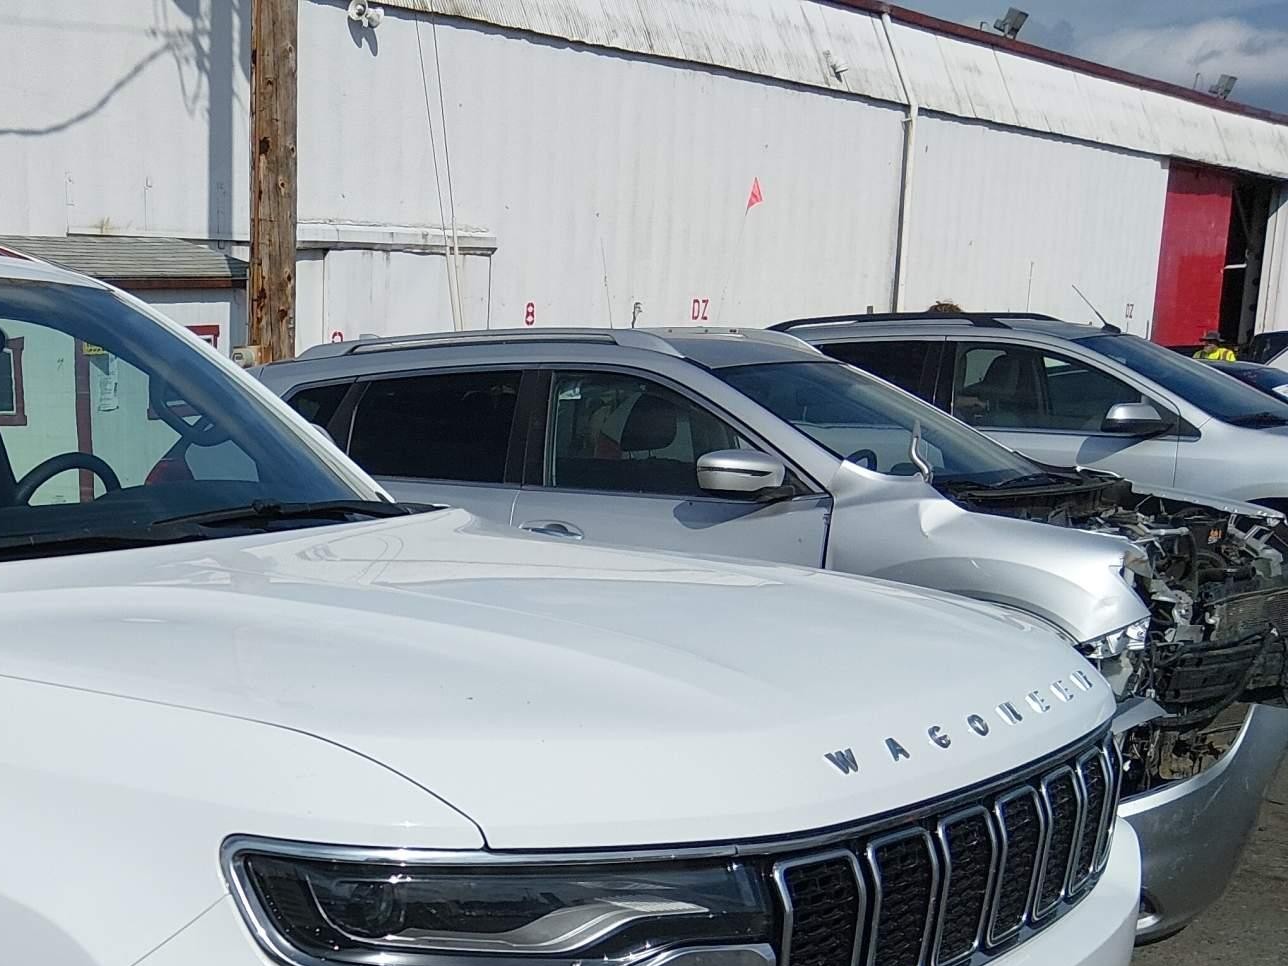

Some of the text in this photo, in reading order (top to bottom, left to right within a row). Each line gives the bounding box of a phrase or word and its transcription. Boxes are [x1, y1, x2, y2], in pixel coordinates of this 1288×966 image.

[524, 301, 535, 326] 8
[691, 298, 709, 321] DZ
[823, 670, 1093, 775] WAGONEER
